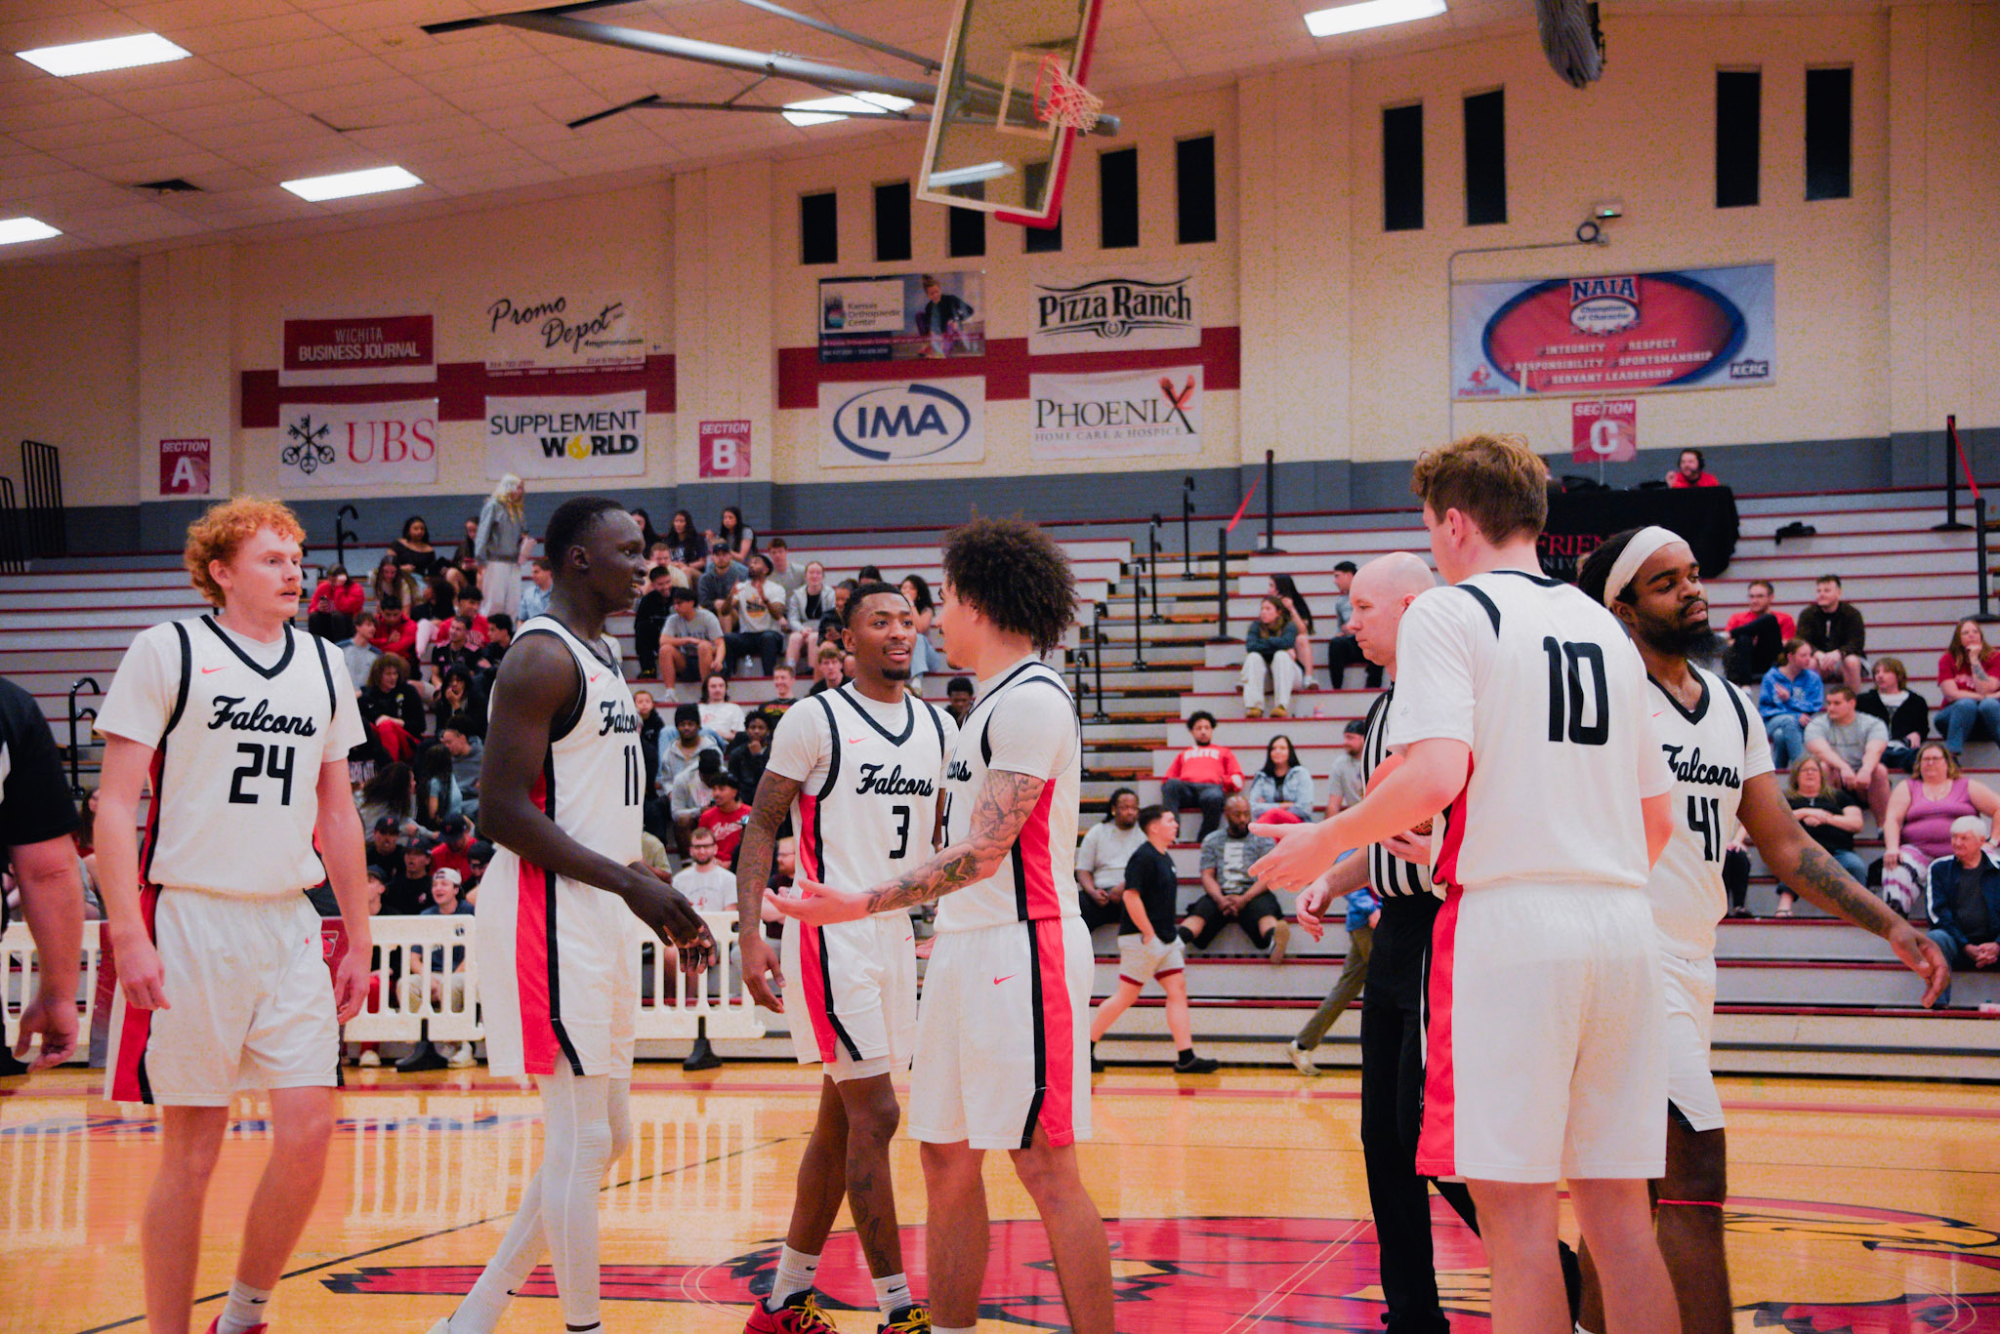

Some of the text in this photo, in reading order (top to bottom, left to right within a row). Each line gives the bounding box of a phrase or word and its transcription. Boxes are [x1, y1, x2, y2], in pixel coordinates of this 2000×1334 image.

[1038, 286, 1192, 328] Pizza Ranch
[1571, 278, 1636, 302] NAIA
[487, 297, 566, 333] Promo
[541, 302, 622, 353] Depot
[299, 341, 420, 361] BUSINESS JOURNAL
[335, 327, 384, 343] WICHITA
[1545, 339, 1678, 356] INTEGRITY RESPECT
[1514, 351, 1712, 371] RESPONSIBILITY SPORTSMANSHIP
[1552, 369, 1674, 384] SERVANT LEADERSHIP
[490, 410, 641, 435] SUPPLEMENT
[857, 404, 949, 438] IMA
[1036, 384, 1196, 434] PHOENIX
[1574, 403, 1634, 417] SECTION
[346, 418, 436, 464] UBS
[702, 423, 749, 435] SECTION
[1035, 427, 1182, 442] HOME CARE & HOSPICE
[1591, 420, 1618, 454] C
[162, 442, 209, 453] SECTION
[540, 434, 640, 459] WORLD
[713, 440, 737, 470] B
[171, 456, 196, 487] A
[1543, 635, 1609, 746] 10
[207, 695, 317, 737] Falcons
[599, 699, 638, 736] Falco
[228, 742, 295, 806] 24
[624, 744, 639, 806] 11
[856, 763, 935, 797] Falcons
[1662, 744, 1740, 789] Falcons
[889, 805, 910, 859] 3
[1687, 795, 1721, 862] 41
